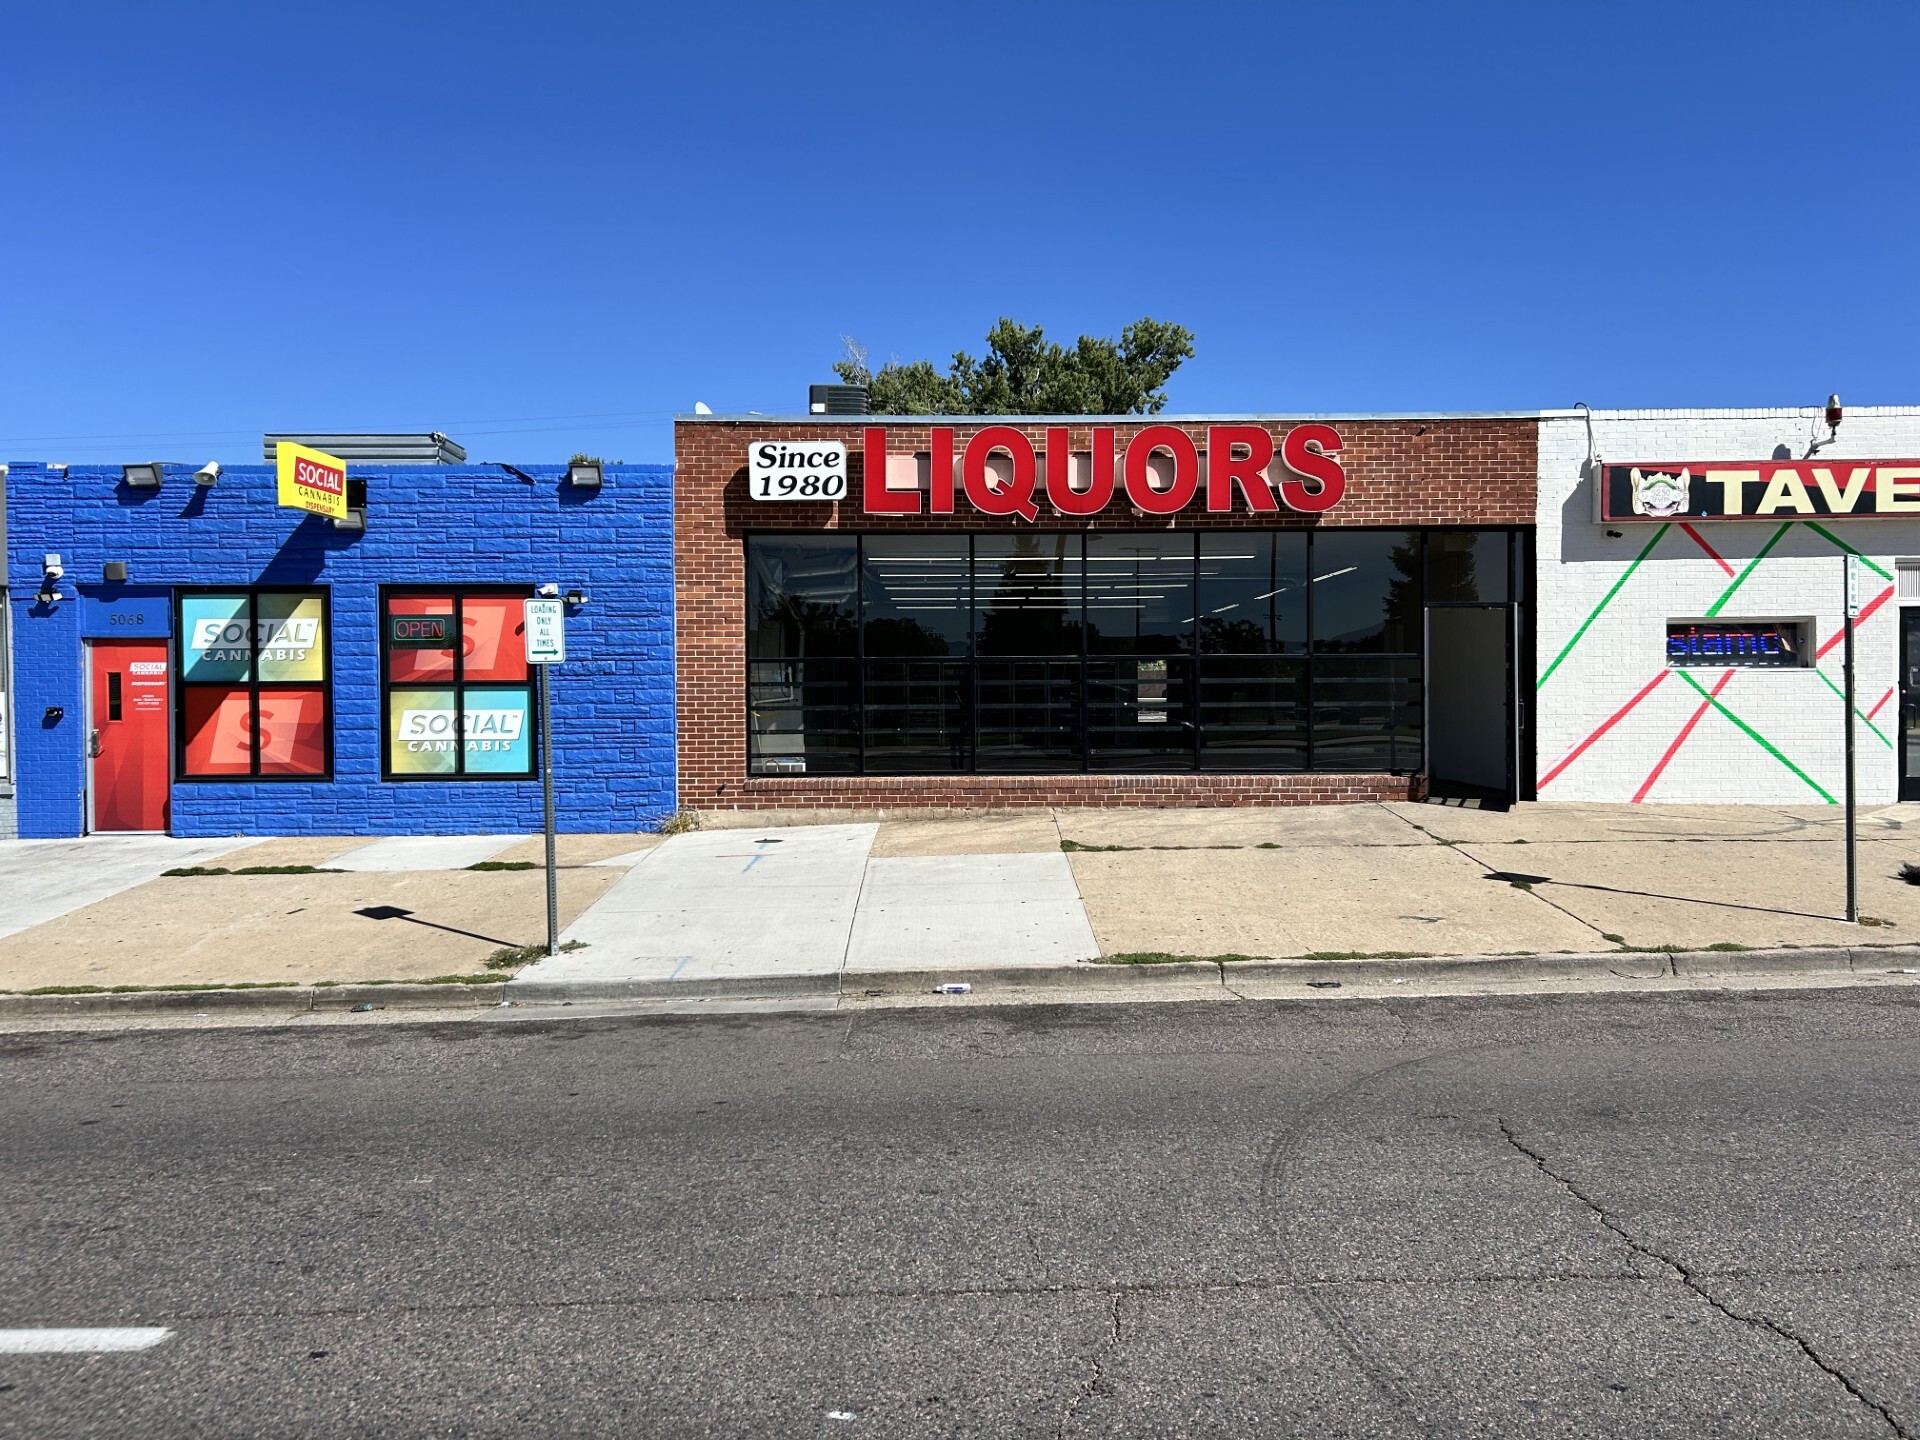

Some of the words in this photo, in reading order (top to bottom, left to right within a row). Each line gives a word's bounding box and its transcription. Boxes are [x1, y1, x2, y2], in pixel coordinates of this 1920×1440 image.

[756, 444, 840, 469] Since
[298, 462, 341, 491] SOCIAL
[863, 424, 1346, 523] LIQUORS
[759, 475, 844, 496] 1980
[298, 486, 340, 506] CANNABIS
[305, 501, 334, 515] DISPENSARY
[531, 604, 557, 613] LOADING
[110, 613, 144, 625] 5068
[537, 616, 551, 625] ONLY
[204, 623, 308, 644] SOCIAL
[396, 621, 443, 637] OPEN
[540, 628, 550, 636] ALL
[537, 639, 554, 647] TIMES
[202, 649, 306, 661] CANNABIS
[410, 714, 513, 735] SOCIAL
[407, 740, 512, 752] CANNABIS
